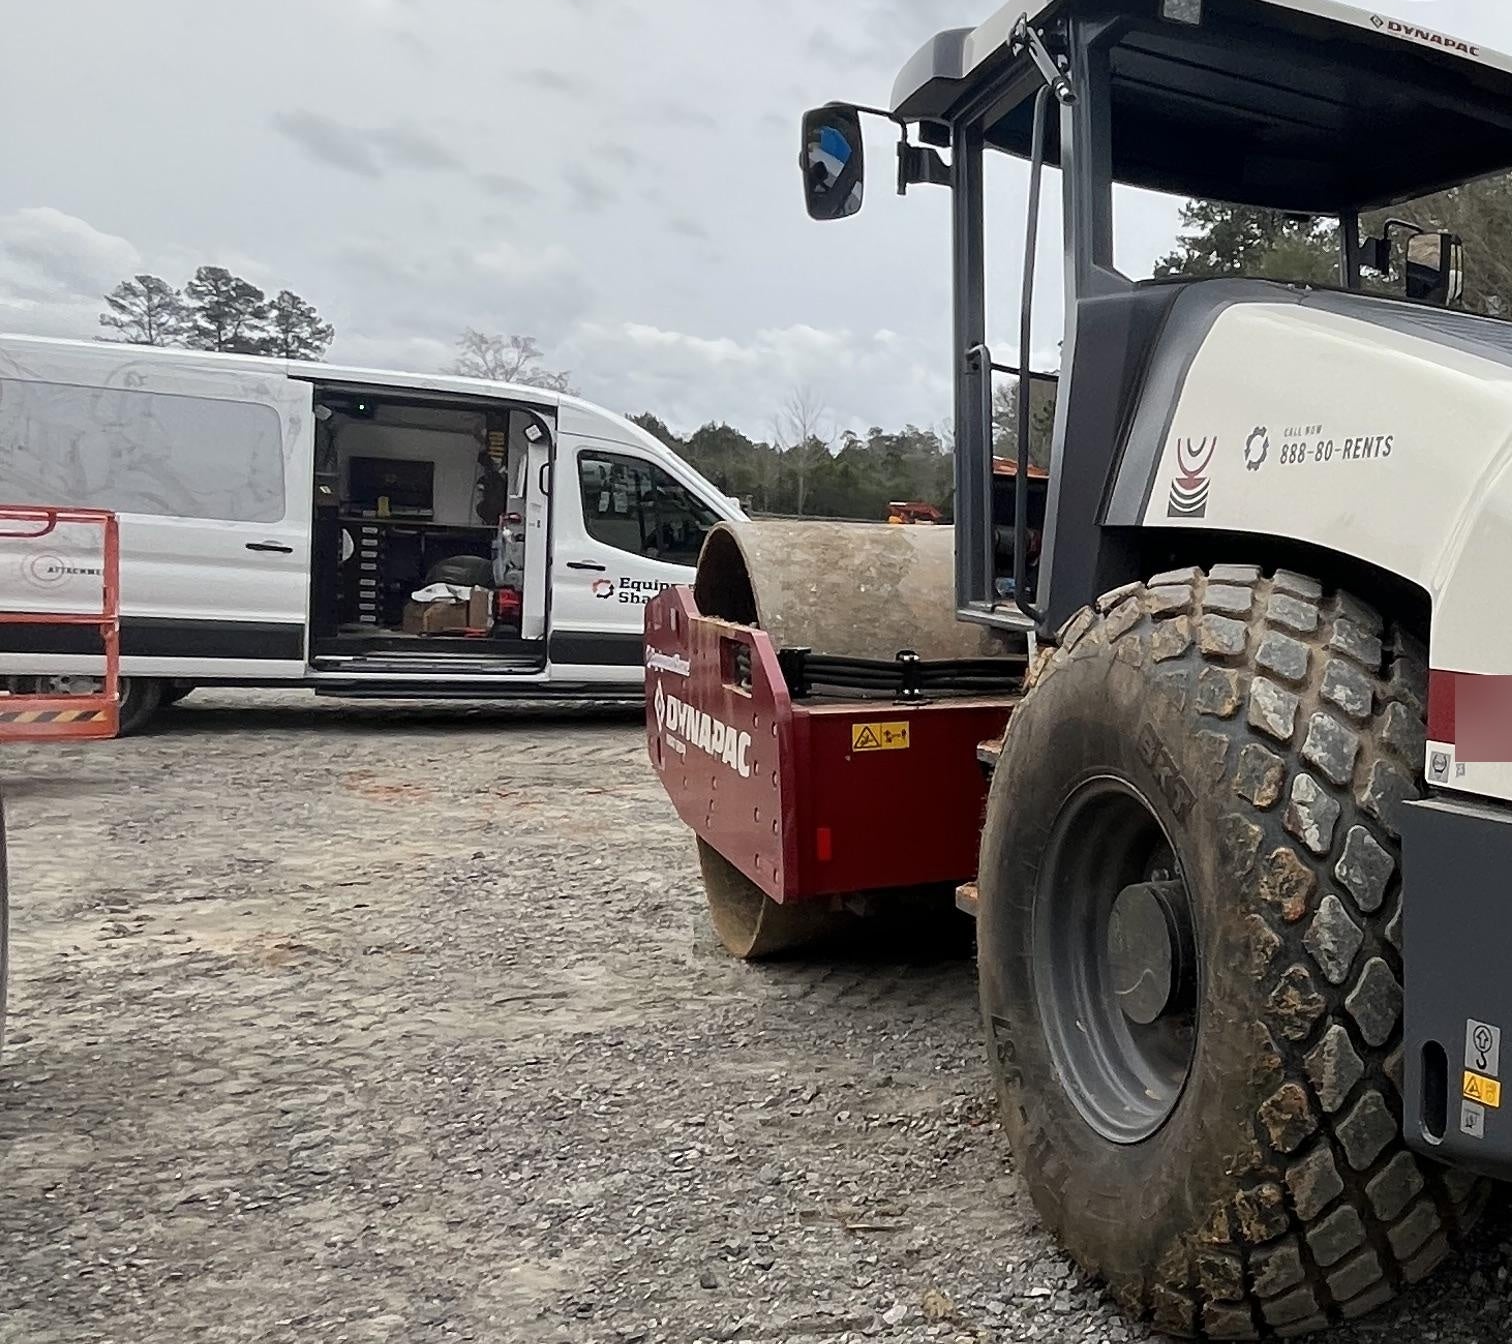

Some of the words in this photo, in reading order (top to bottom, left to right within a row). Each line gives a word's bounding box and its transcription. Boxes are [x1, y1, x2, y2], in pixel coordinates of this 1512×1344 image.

[1387, 20, 1480, 56] DYNAPAC
[1280, 435, 1394, 464] 888-80-RENTS
[618, 592, 652, 604] Sha
[665, 694, 751, 778] DYNAPAC
